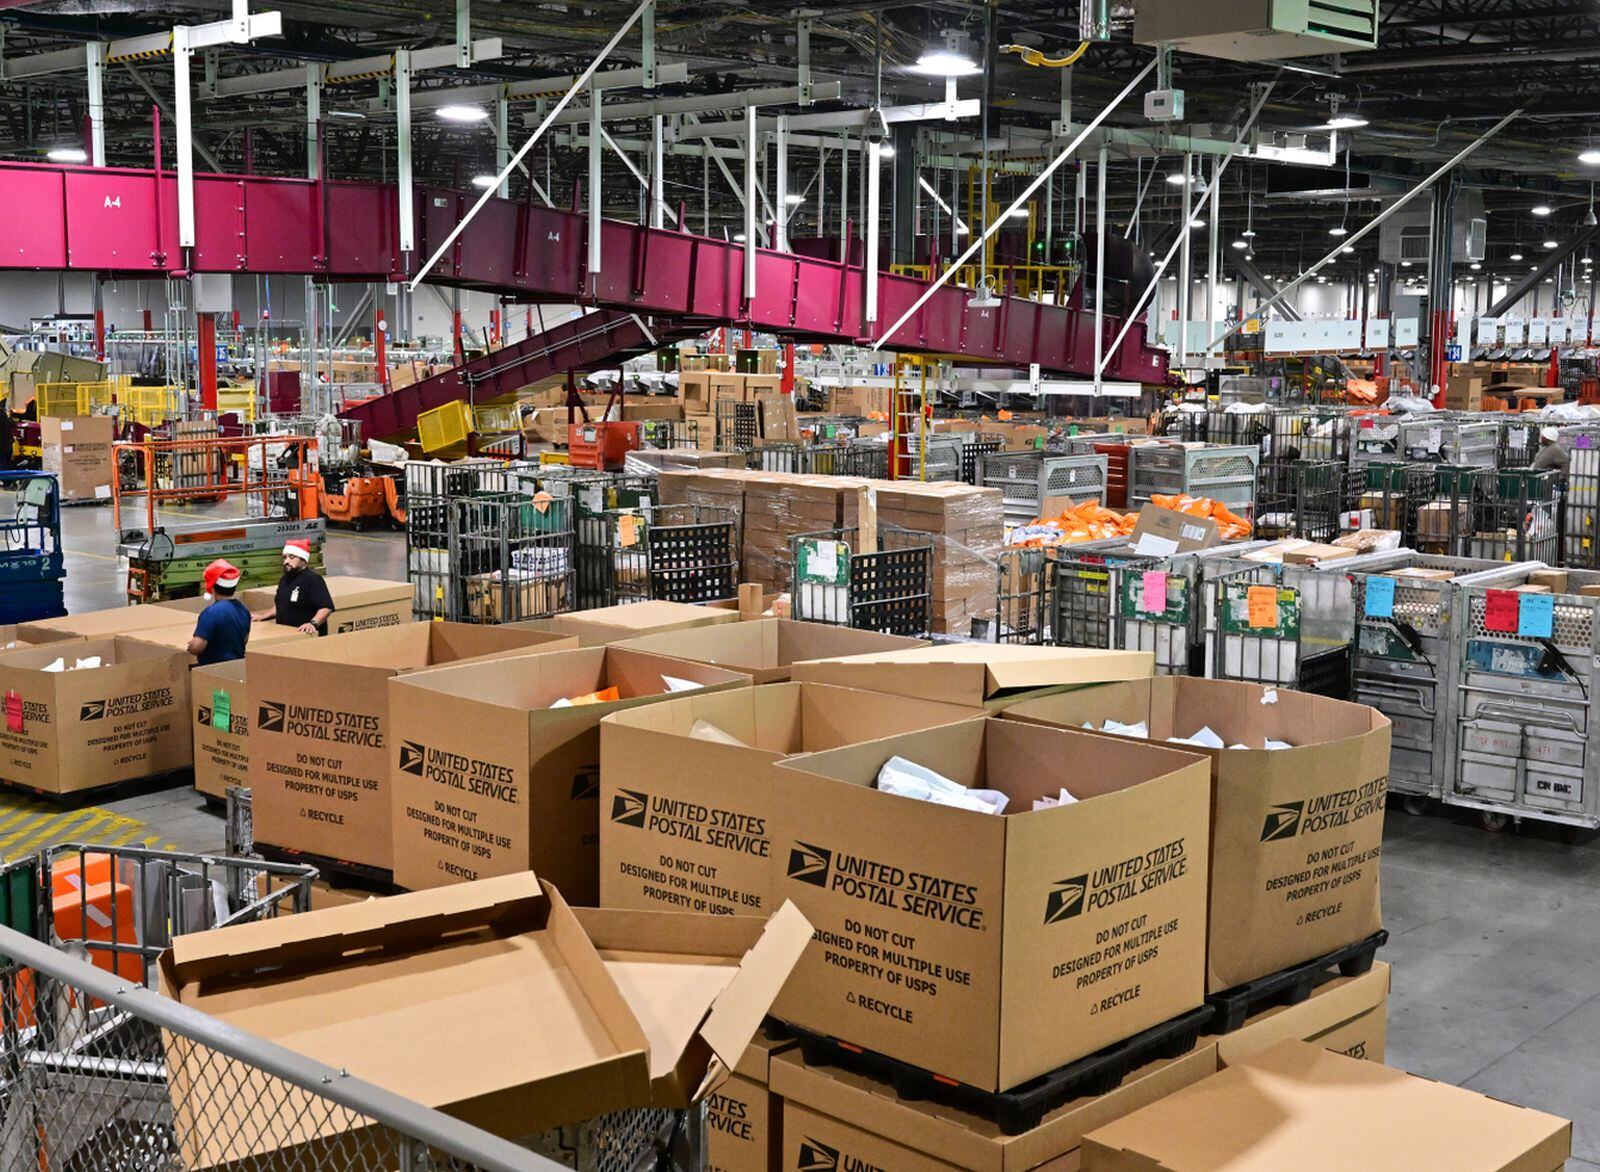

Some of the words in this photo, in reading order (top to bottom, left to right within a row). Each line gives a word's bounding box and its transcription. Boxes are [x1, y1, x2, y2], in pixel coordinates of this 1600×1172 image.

[42, 557, 50, 570] 2
[355, 617, 378, 627] UNITED
[379, 613, 399, 623] STATES
[24, 701, 48, 712] STATES
[106, 705, 140, 718] POSTAL
[141, 697, 173, 711] SERVICE
[108, 693, 141, 707] UNITED
[143, 687, 171, 700] STATES
[113, 725, 123, 733] DO
[124, 723, 136, 731] NOT
[288, 704, 333, 724] UNITED
[335, 712, 380, 731] STATES
[88, 736, 118, 746] DESIGNED
[132, 728, 159, 738] MULTIPLE
[103, 741, 133, 752] PROPERTY
[287, 721, 330, 741] POSTAL
[333, 729, 383, 749] SERVICE
[120, 753, 146, 764] RECYCLE
[297, 754, 308, 764] DO
[310, 755, 325, 767] NOT
[327, 758, 342, 770] CUT
[427, 748, 469, 772] UNITED
[471, 760, 514, 784] STATES
[266, 762, 303, 778] DESIGNED
[305, 769, 320, 781] FOR
[322, 772, 361, 788] MULTIPLE
[363, 778, 378, 790] USE
[426, 765, 465, 790] POSTAL
[468, 777, 518, 804] SERVICE
[285, 780, 324, 795] PROPERTY
[326, 787, 336, 797] OF
[337, 789, 358, 801] USPS
[1307, 788, 1356, 814] UNITED
[308, 809, 344, 825] RECYCLE
[435, 800, 444, 812] DO
[447, 803, 461, 818] NOT
[463, 809, 477, 822] CUT
[652, 796, 707, 822] UNITED
[710, 809, 765, 835] STATES
[1301, 811, 1349, 835] POSTAL
[1351, 795, 1387, 822] SERVIC
[407, 806, 441, 827] DESIGNED
[442, 817, 456, 832] FOR
[457, 821, 494, 844] MULTIPLE
[496, 835, 511, 849] USE
[649, 815, 702, 843] POSTAL
[706, 828, 770, 857] SERVICE
[424, 827, 459, 849] PROPERTY
[461, 840, 470, 851] OF
[472, 844, 492, 859] USPS
[1307, 852, 1320, 864] DO
[1322, 846, 1338, 862] NOT
[1340, 841, 1355, 856] CUT
[445, 862, 478, 881] RECYCLE
[660, 855, 673, 868] DO
[676, 857, 695, 874] NOT
[698, 865, 717, 879] CUT
[1092, 856, 1143, 888] UNITED
[1145, 838, 1184, 870] STATES
[1266, 868, 1310, 891] DESIGNED
[1313, 864, 1329, 879] FOR
[1331, 852, 1366, 875] MULTIPLE
[1367, 847, 1380, 860] USE
[620, 862, 666, 884] DESIGNED
[669, 874, 687, 889] FOR
[690, 881, 738, 902] MULTIPLE
[742, 893, 761, 908] USE
[832, 874, 898, 909] POSTAL
[835, 853, 904, 887] UNITED
[907, 872, 978, 905] STATES
[1087, 879, 1137, 912] POSTAL
[1140, 858, 1187, 894] SERVICE
[1286, 881, 1329, 902] PROPERTY
[1331, 877, 1340, 889] OF
[1343, 869, 1362, 884] USPS
[643, 885, 691, 908] PROPERTY
[694, 899, 706, 911] OF
[709, 903, 734, 916] USPS
[1305, 902, 1342, 923] RECYCLE
[845, 919, 861, 934] DO
[864, 924, 888, 942] NOT
[892, 932, 915, 950] CUT
[1096, 929, 1109, 944] DO
[1111, 920, 1129, 939] NOT
[1131, 914, 1147, 931] CUT
[812, 929, 853, 951] SIGNED
[856, 941, 879, 959] FOR
[882, 949, 942, 978] MULTIPLE
[946, 968, 970, 986] USE
[1052, 952, 1101, 979] DESIGNED
[1104, 944, 1121, 961] FOR
[1123, 925, 1162, 951] MULTIPLE
[1164, 918, 1178, 935] USE
[825, 951, 884, 980] PROPERTY
[887, 970, 902, 985] OF
[905, 976, 937, 996] USPS
[1076, 961, 1122, 989] PROPERTY
[1125, 956, 1136, 970] OF
[1138, 946, 1159, 965] USPS
[859, 995, 913, 1024] RECYCLE
[1100, 985, 1141, 1012] RECYCLE
[708, 1093, 748, 1119] ATES
[709, 1111, 752, 1141] RVICE
